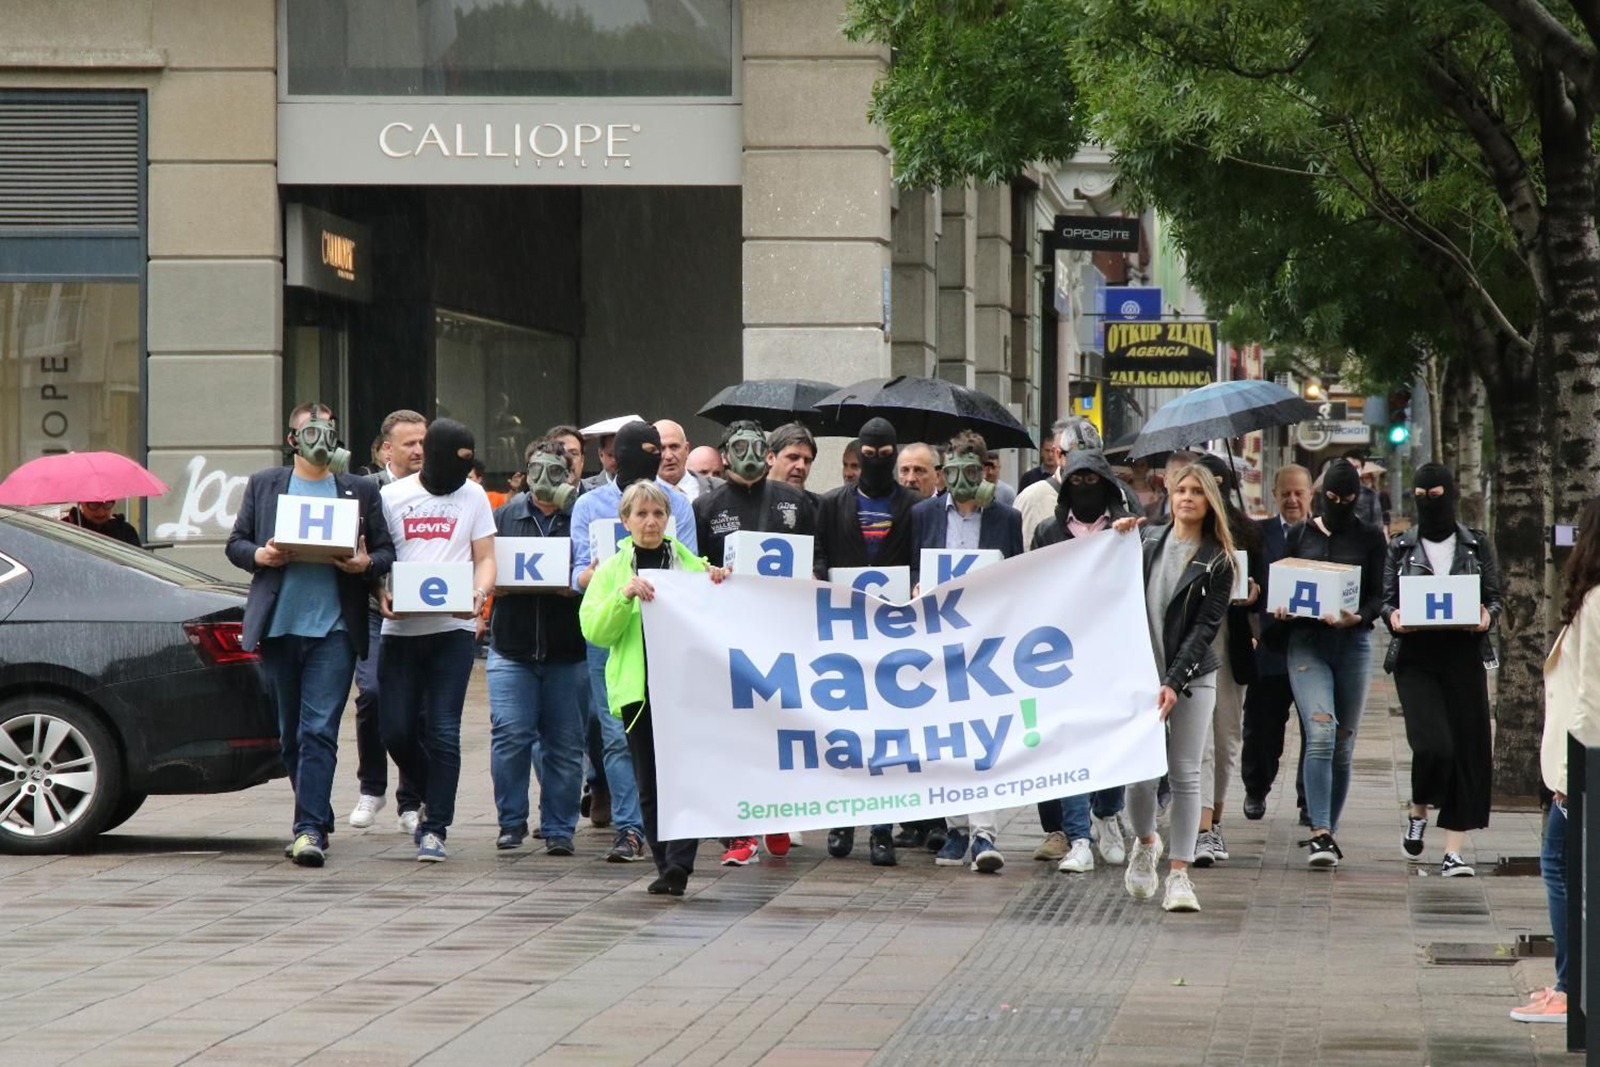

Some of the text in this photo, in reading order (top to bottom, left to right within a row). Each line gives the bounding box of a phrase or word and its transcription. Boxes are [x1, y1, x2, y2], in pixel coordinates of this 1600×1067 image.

[379, 121, 632, 158] CALLIOPE
[515, 159, 631, 168] ITALIA
[1062, 227, 1131, 240] OPPOSITE
[1107, 323, 1215, 356] OTKUP ZLATA
[1126, 345, 1189, 357] AGENCIA
[1109, 370, 1213, 386] ZALAGAONICA
[298, 503, 335, 541] Н
[815, 587, 972, 641] Нек
[777, 698, 1042, 777] падну!
[736, 767, 1091, 820] Зелена странка Нова странка
